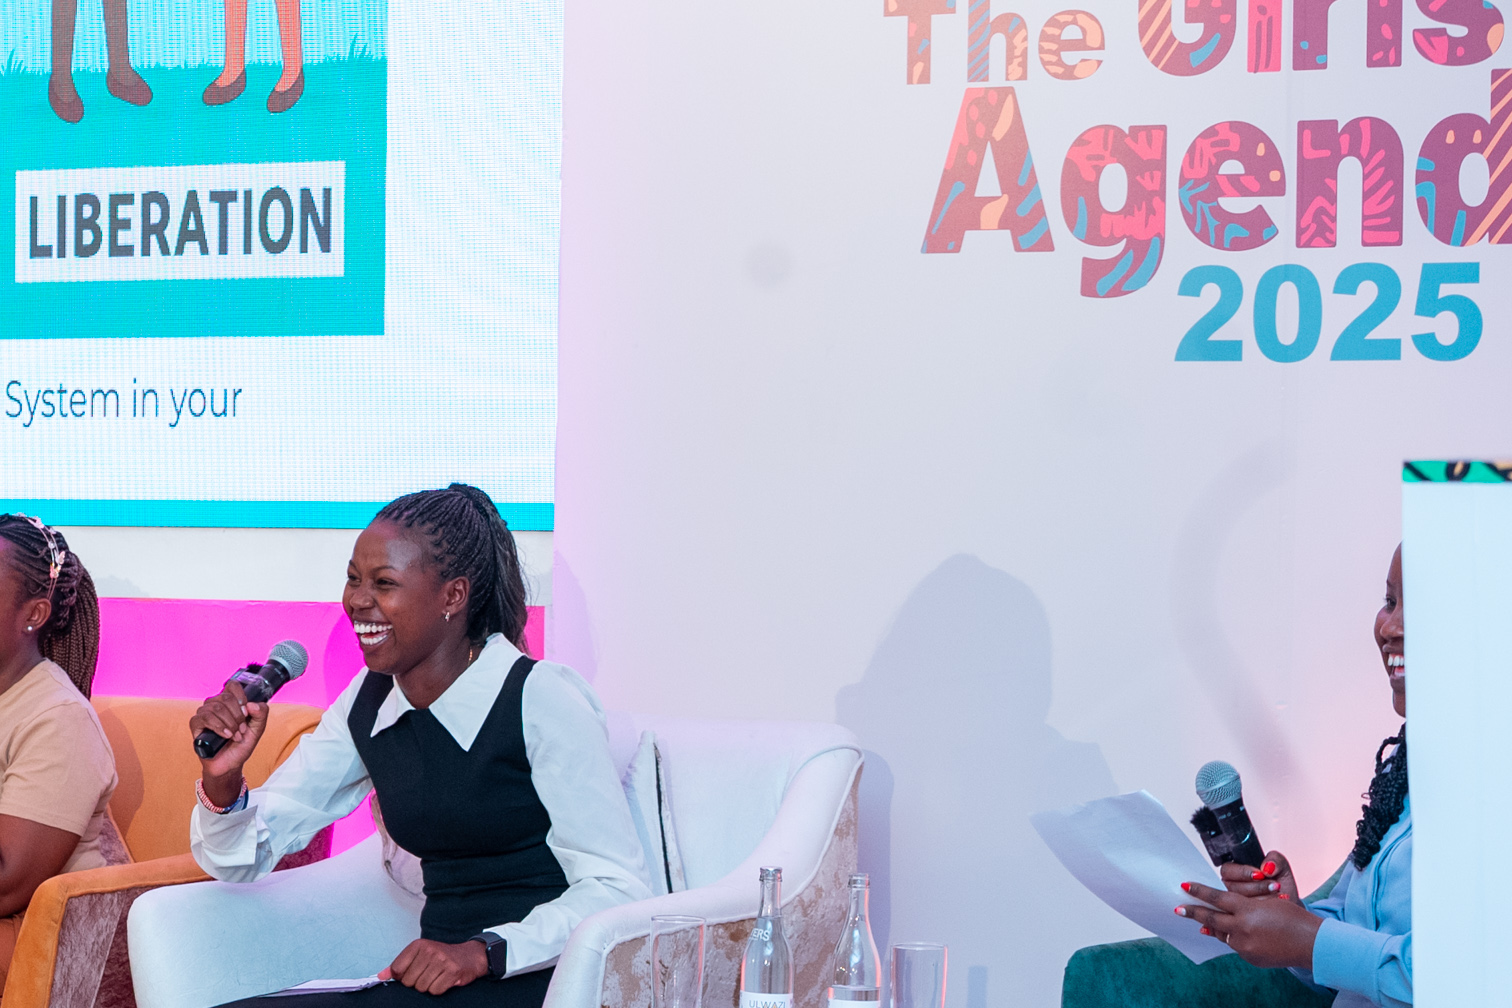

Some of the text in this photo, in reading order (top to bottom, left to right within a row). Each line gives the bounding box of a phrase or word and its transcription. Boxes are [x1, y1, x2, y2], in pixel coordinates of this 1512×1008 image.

[883, 0, 1105, 85] The
[29, 186, 333, 259] LIBERATION
[1174, 261, 1484, 363] 2025
[5, 379, 121, 427] System
[131, 380, 160, 418] in
[168, 383, 243, 427] your
[749, 1000, 786, 1008] ULWAZI
